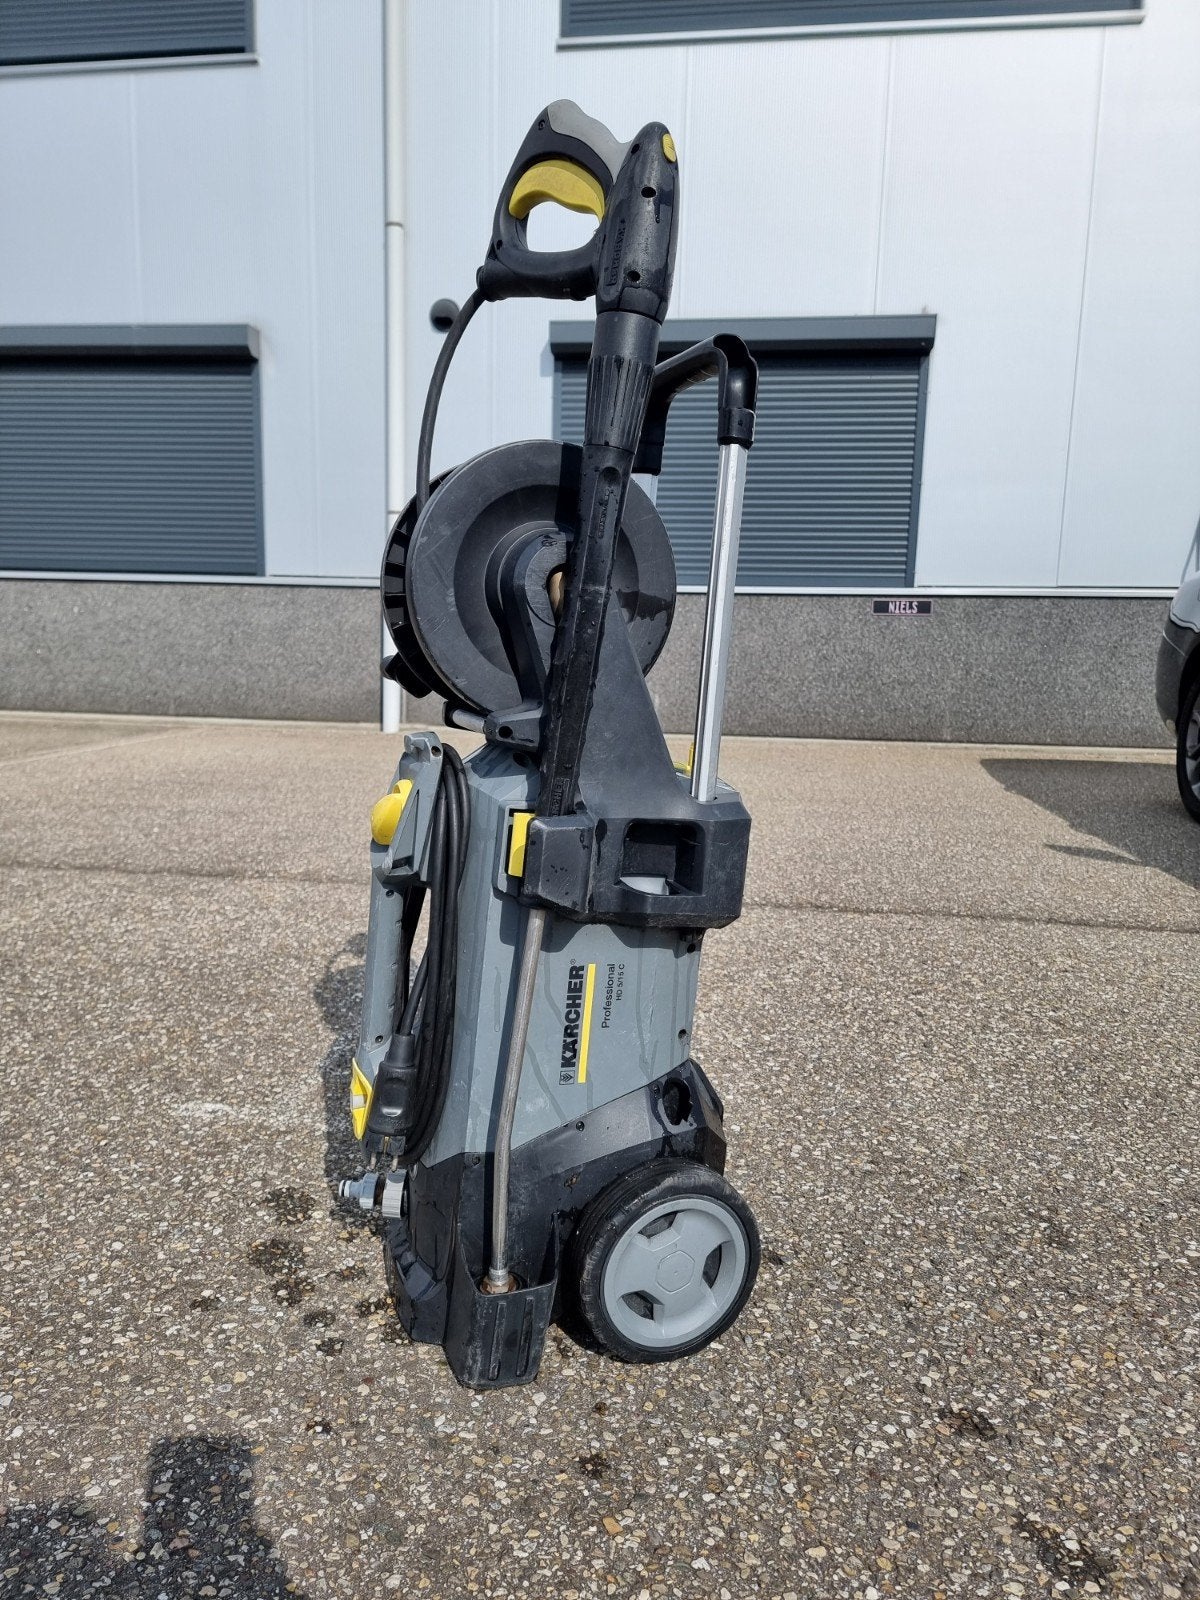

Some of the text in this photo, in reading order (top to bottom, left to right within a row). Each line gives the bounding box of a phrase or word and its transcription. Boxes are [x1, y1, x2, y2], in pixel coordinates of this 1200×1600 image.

[888, 601, 918, 614] NIELS
[602, 963, 615, 1028] Professional
[615, 989, 623, 1001] HD
